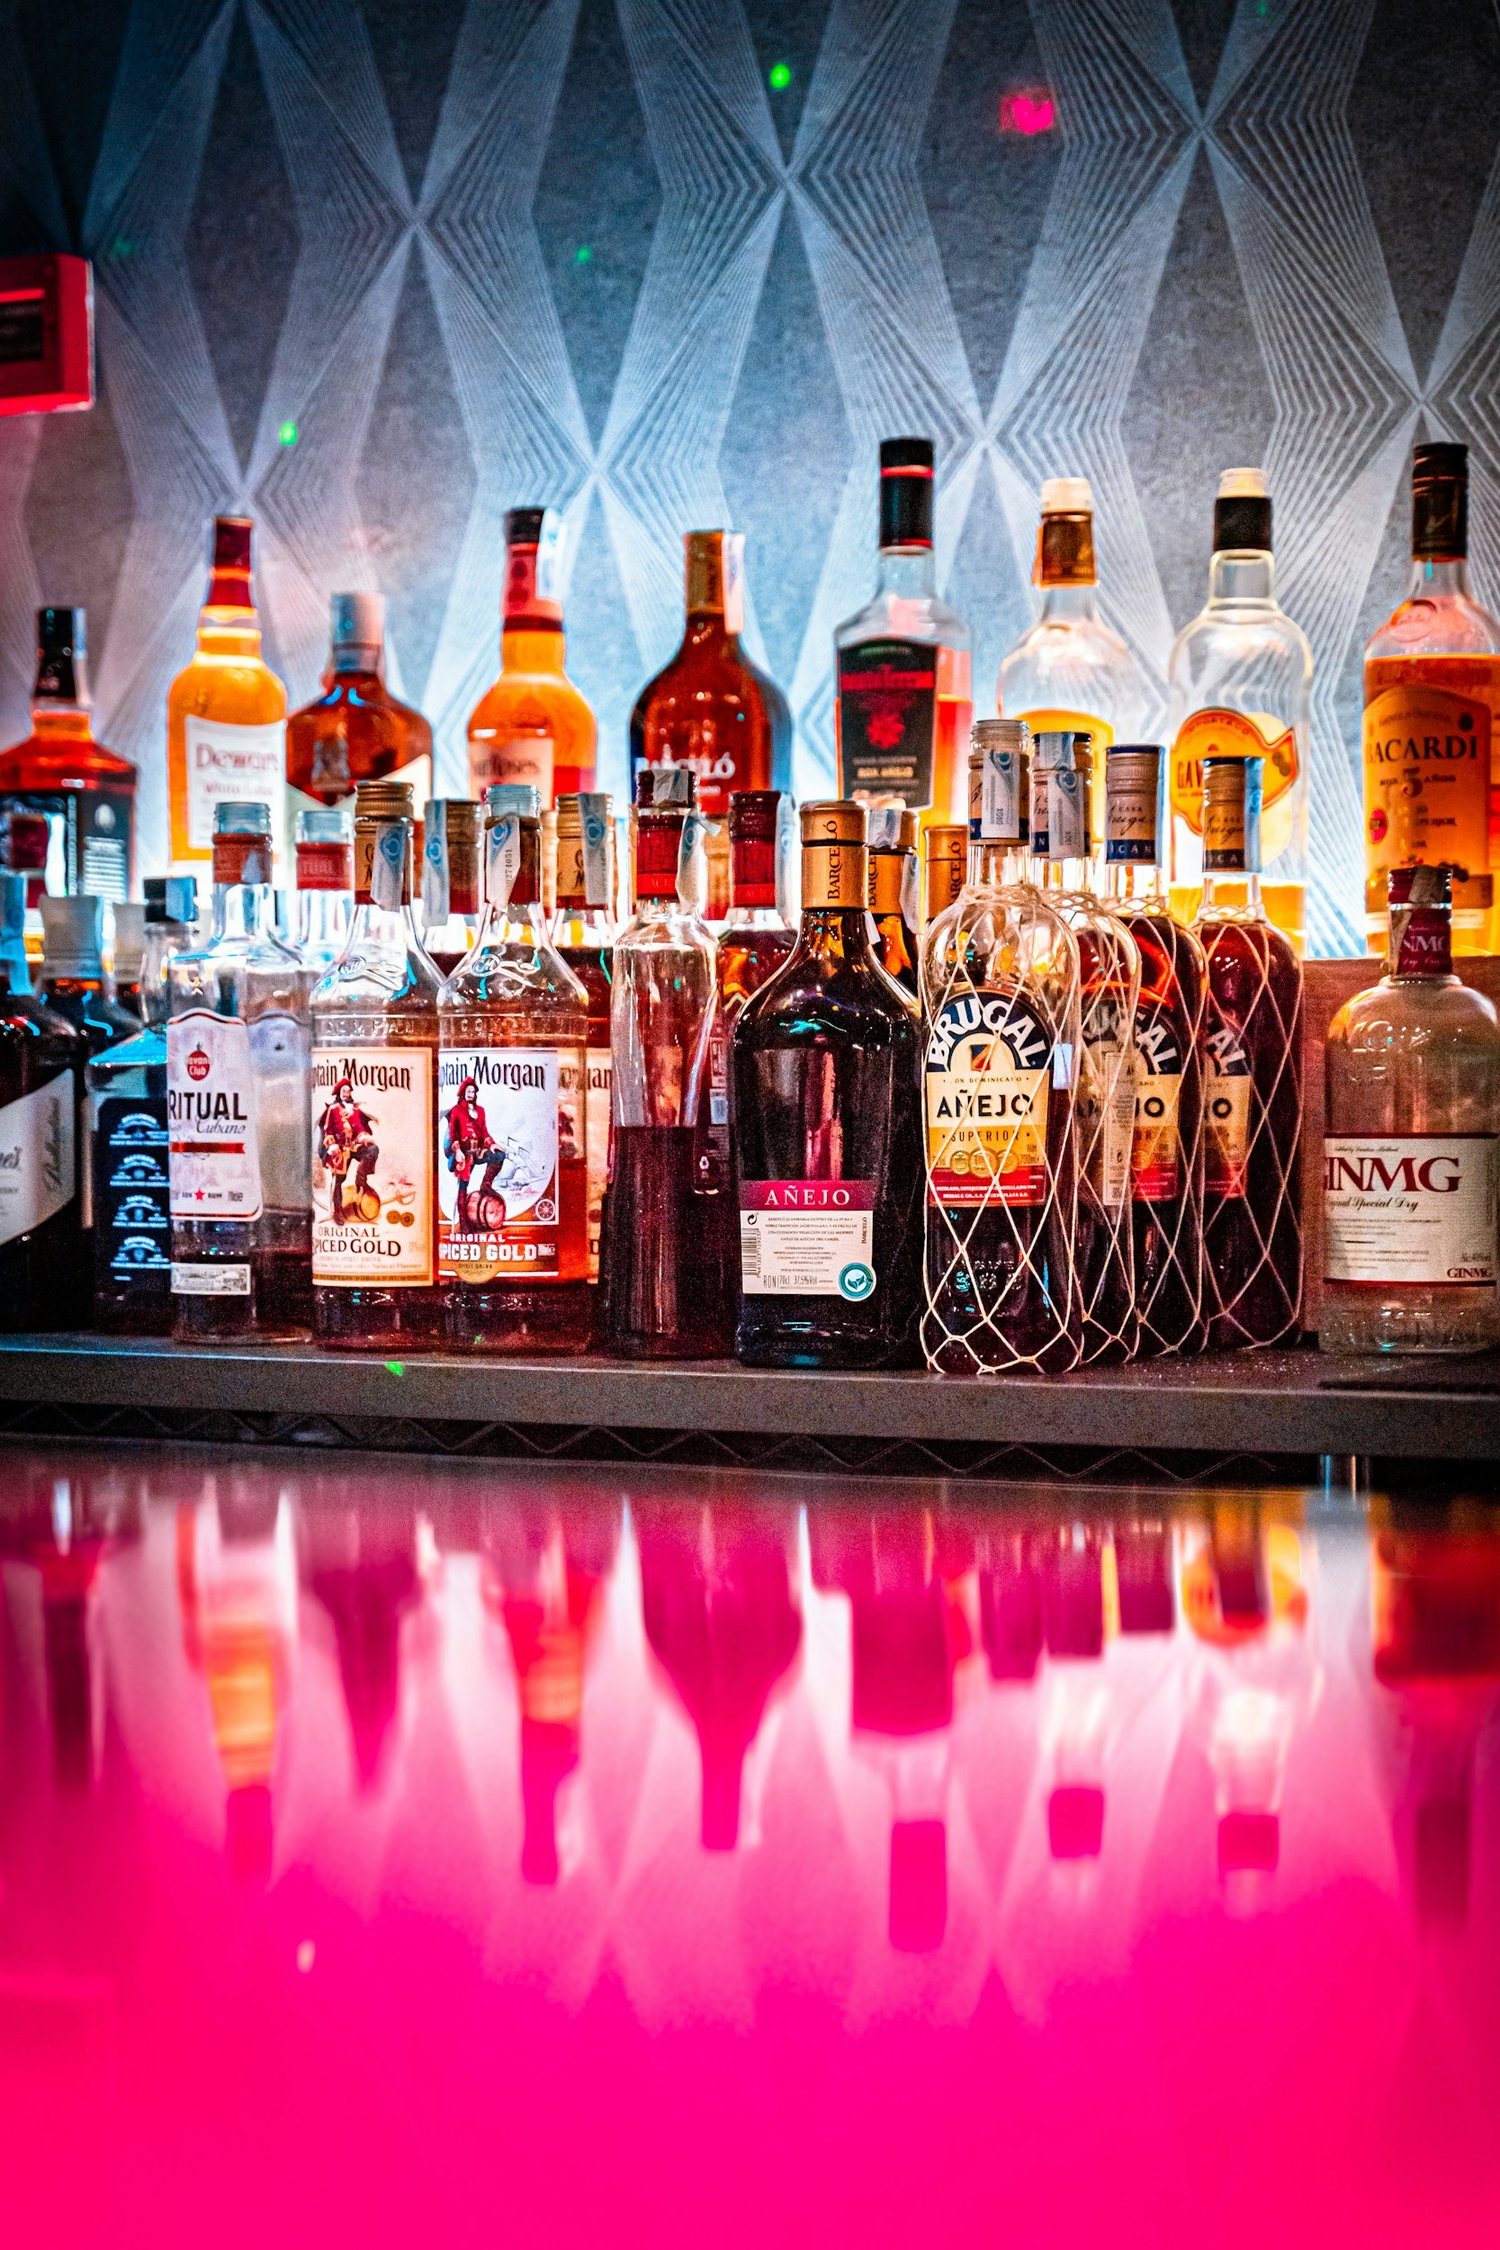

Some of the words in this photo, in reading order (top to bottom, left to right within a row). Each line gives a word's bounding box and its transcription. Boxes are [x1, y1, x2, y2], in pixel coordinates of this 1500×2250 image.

[1403, 766, 1423, 797] 5
[823, 820, 841, 900] BARCELÓ
[949, 841, 963, 900] ARCELÓ
[928, 998, 1047, 1069] BRUGAL
[339, 1058, 410, 1092] Morgan
[469, 1056, 546, 1091] Morgan
[168, 1089, 248, 1120] RITUAL
[937, 1088, 1034, 1118] AÑEJO
[195, 1118, 247, 1135] Cubano
[1325, 1156, 1463, 1193] INMG
[765, 1184, 850, 1206] AÑEJO
[1350, 1196, 1393, 1211] Special
[1394, 1197, 1419, 1213] Dry
[350, 1239, 402, 1257] GOLD
[439, 1243, 481, 1260] PICED
[485, 1243, 538, 1261] GOLD
[450, 1233, 506, 1243] ORIGINAL
